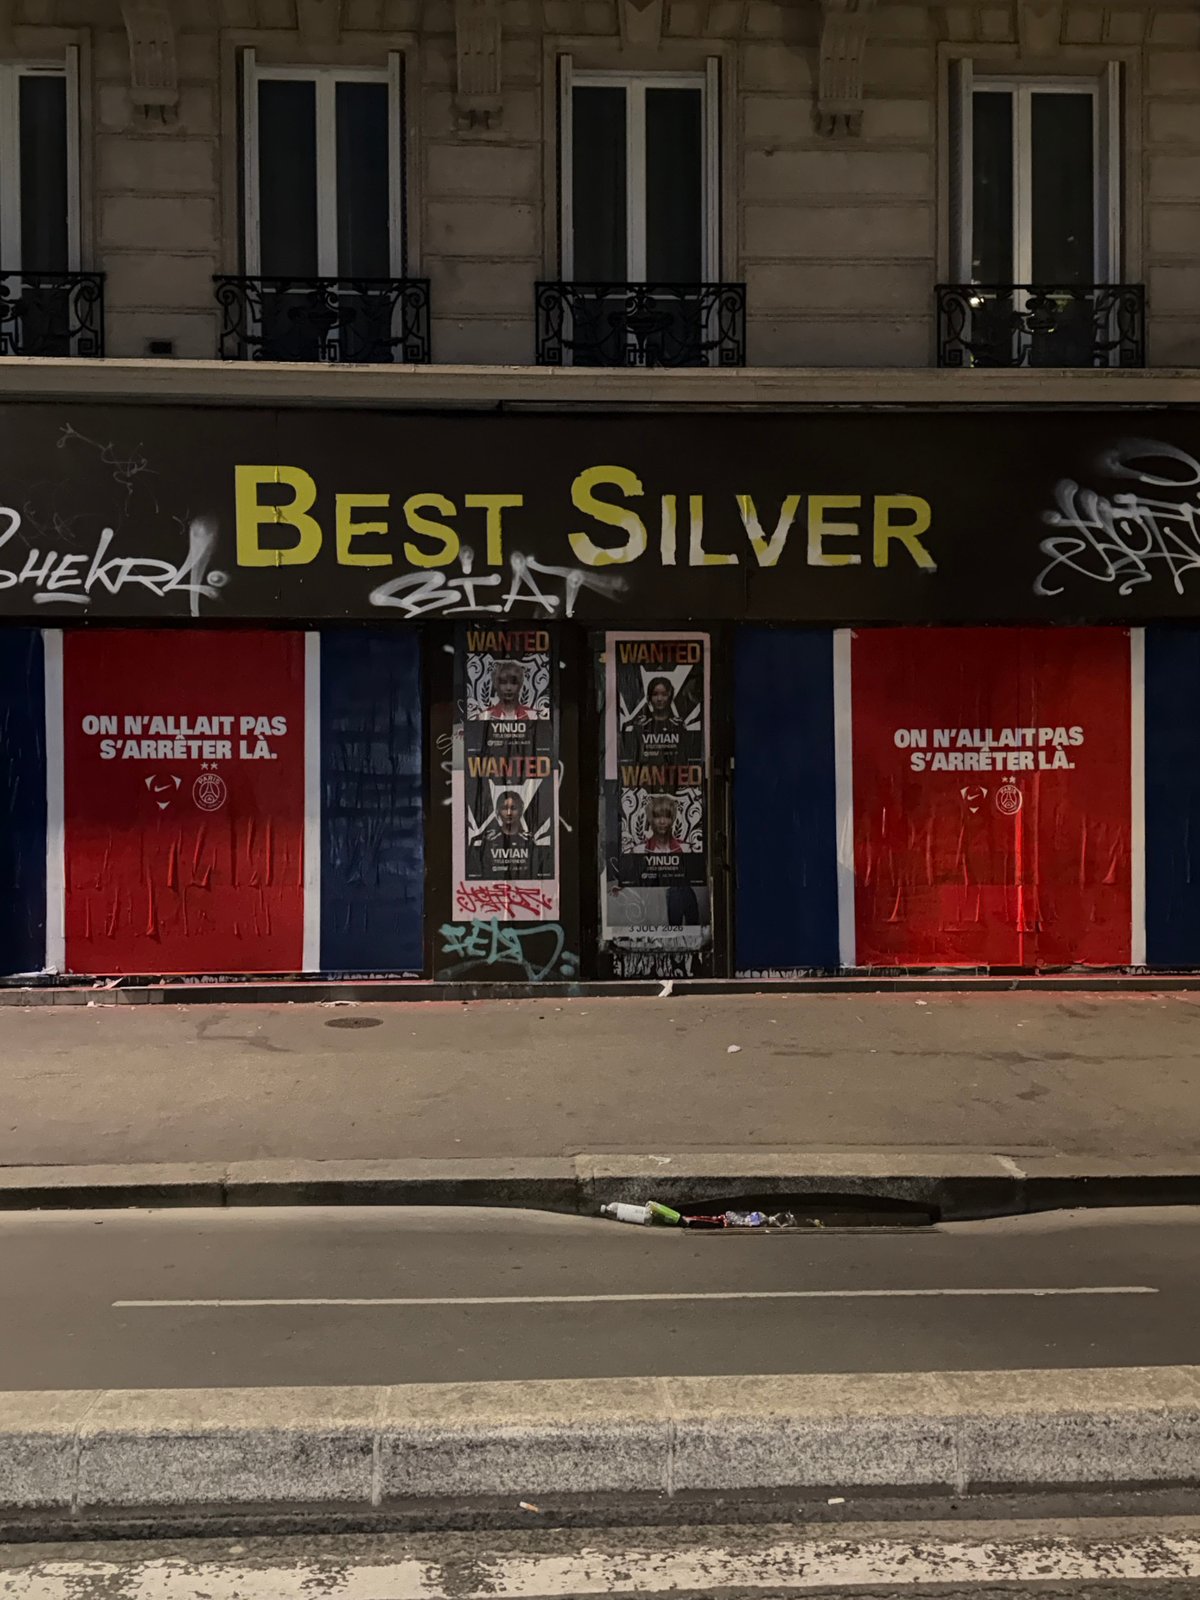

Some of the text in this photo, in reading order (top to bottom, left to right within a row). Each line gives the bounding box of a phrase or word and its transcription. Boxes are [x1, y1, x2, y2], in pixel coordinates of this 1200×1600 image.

[467, 630, 550, 653] WANTED
[620, 642, 702, 665] WANTED
[81, 715, 288, 736] ON N'ALLAIT PAS
[491, 722, 527, 733] YINUO
[99, 734, 278, 760] S'ARRÊTER LÀ.
[642, 733, 680, 744] VIVIAN
[893, 725, 1085, 749] ON N'ALLAIT PAS
[468, 756, 552, 778] WANTED
[910, 746, 1076, 772] S'ARRÊTER LÀ.
[621, 764, 703, 787] WANTED
[490, 848, 529, 859] VIVIAN
[645, 855, 680, 866] YINUO
